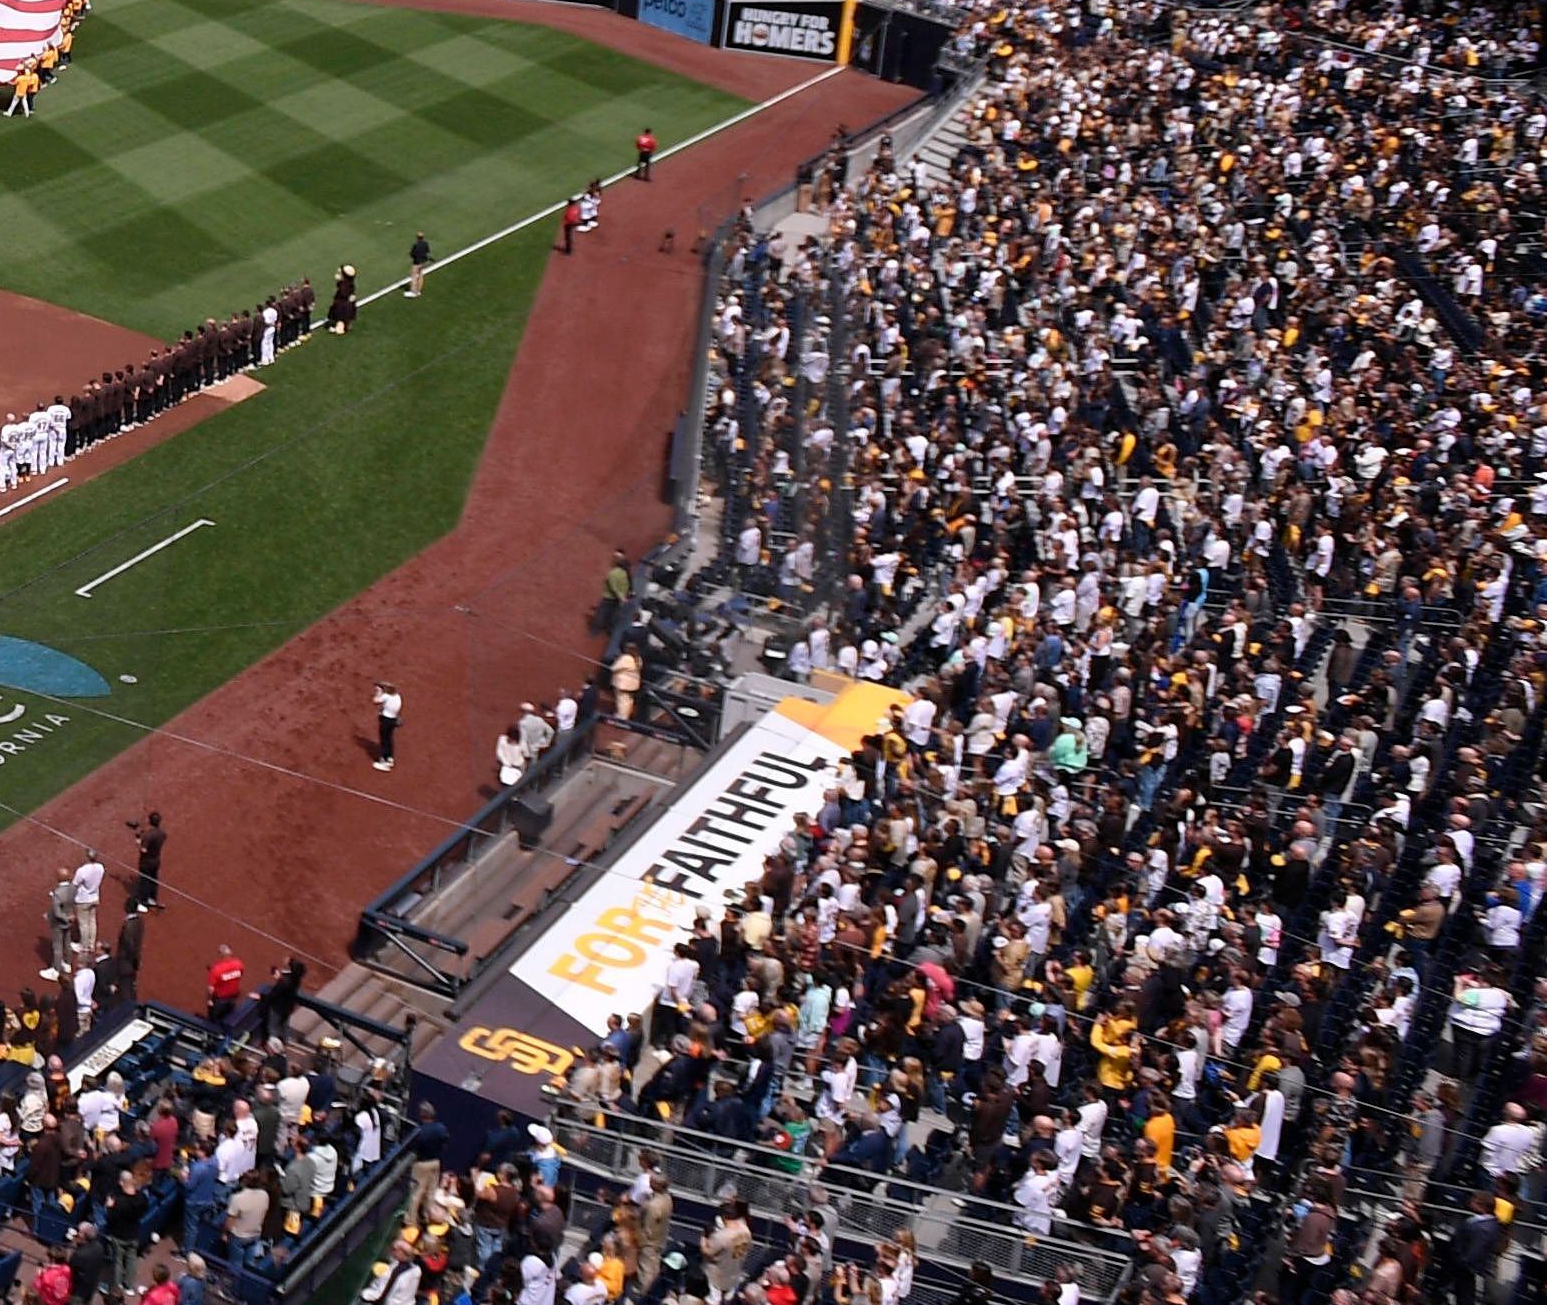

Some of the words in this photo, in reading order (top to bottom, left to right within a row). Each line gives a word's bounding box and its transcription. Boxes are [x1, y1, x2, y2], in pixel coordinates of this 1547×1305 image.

[740, 7, 799, 28] HUNGRY
[800, 13, 830, 30] FOR
[546, 903, 676, 995] FOR
[639, 751, 828, 901] FAITHFUL
